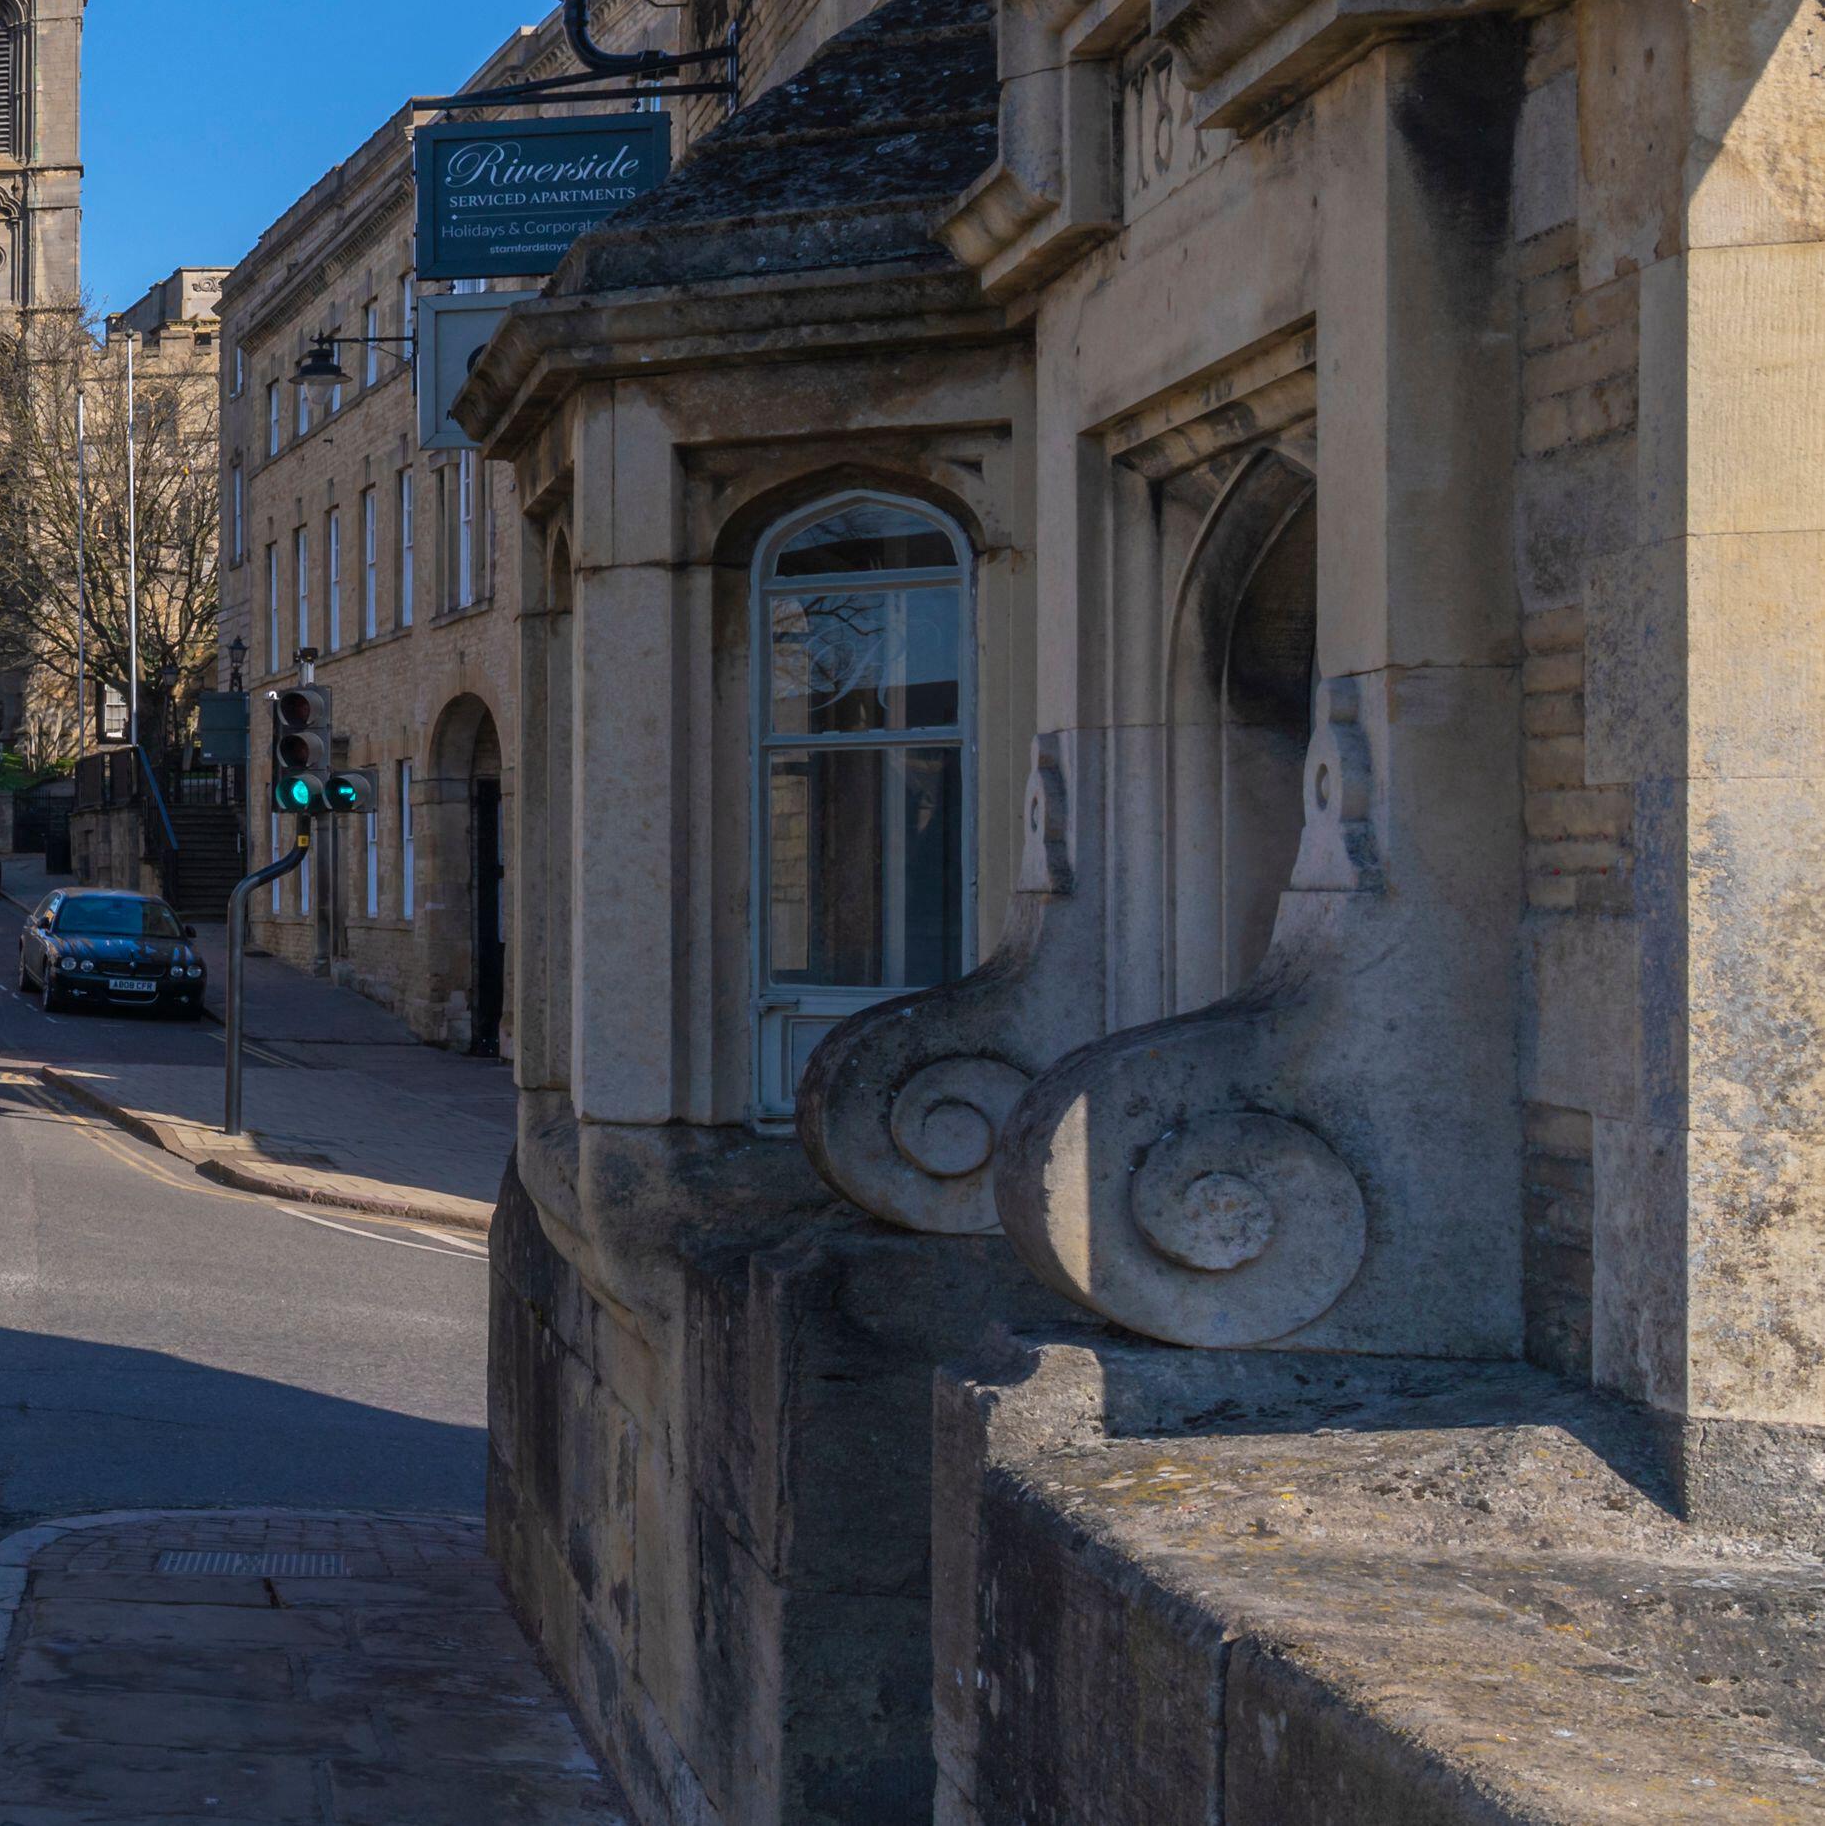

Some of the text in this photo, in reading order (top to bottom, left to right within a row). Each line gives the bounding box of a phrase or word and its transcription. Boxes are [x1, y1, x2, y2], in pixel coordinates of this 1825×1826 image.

[445, 141, 640, 188] Riverside
[449, 187, 636, 208] SERVICED APARTMENTS
[441, 223, 505, 239] Holidays
[509, 223, 520, 236] &
[489, 243, 571, 255] stamfordstays.
